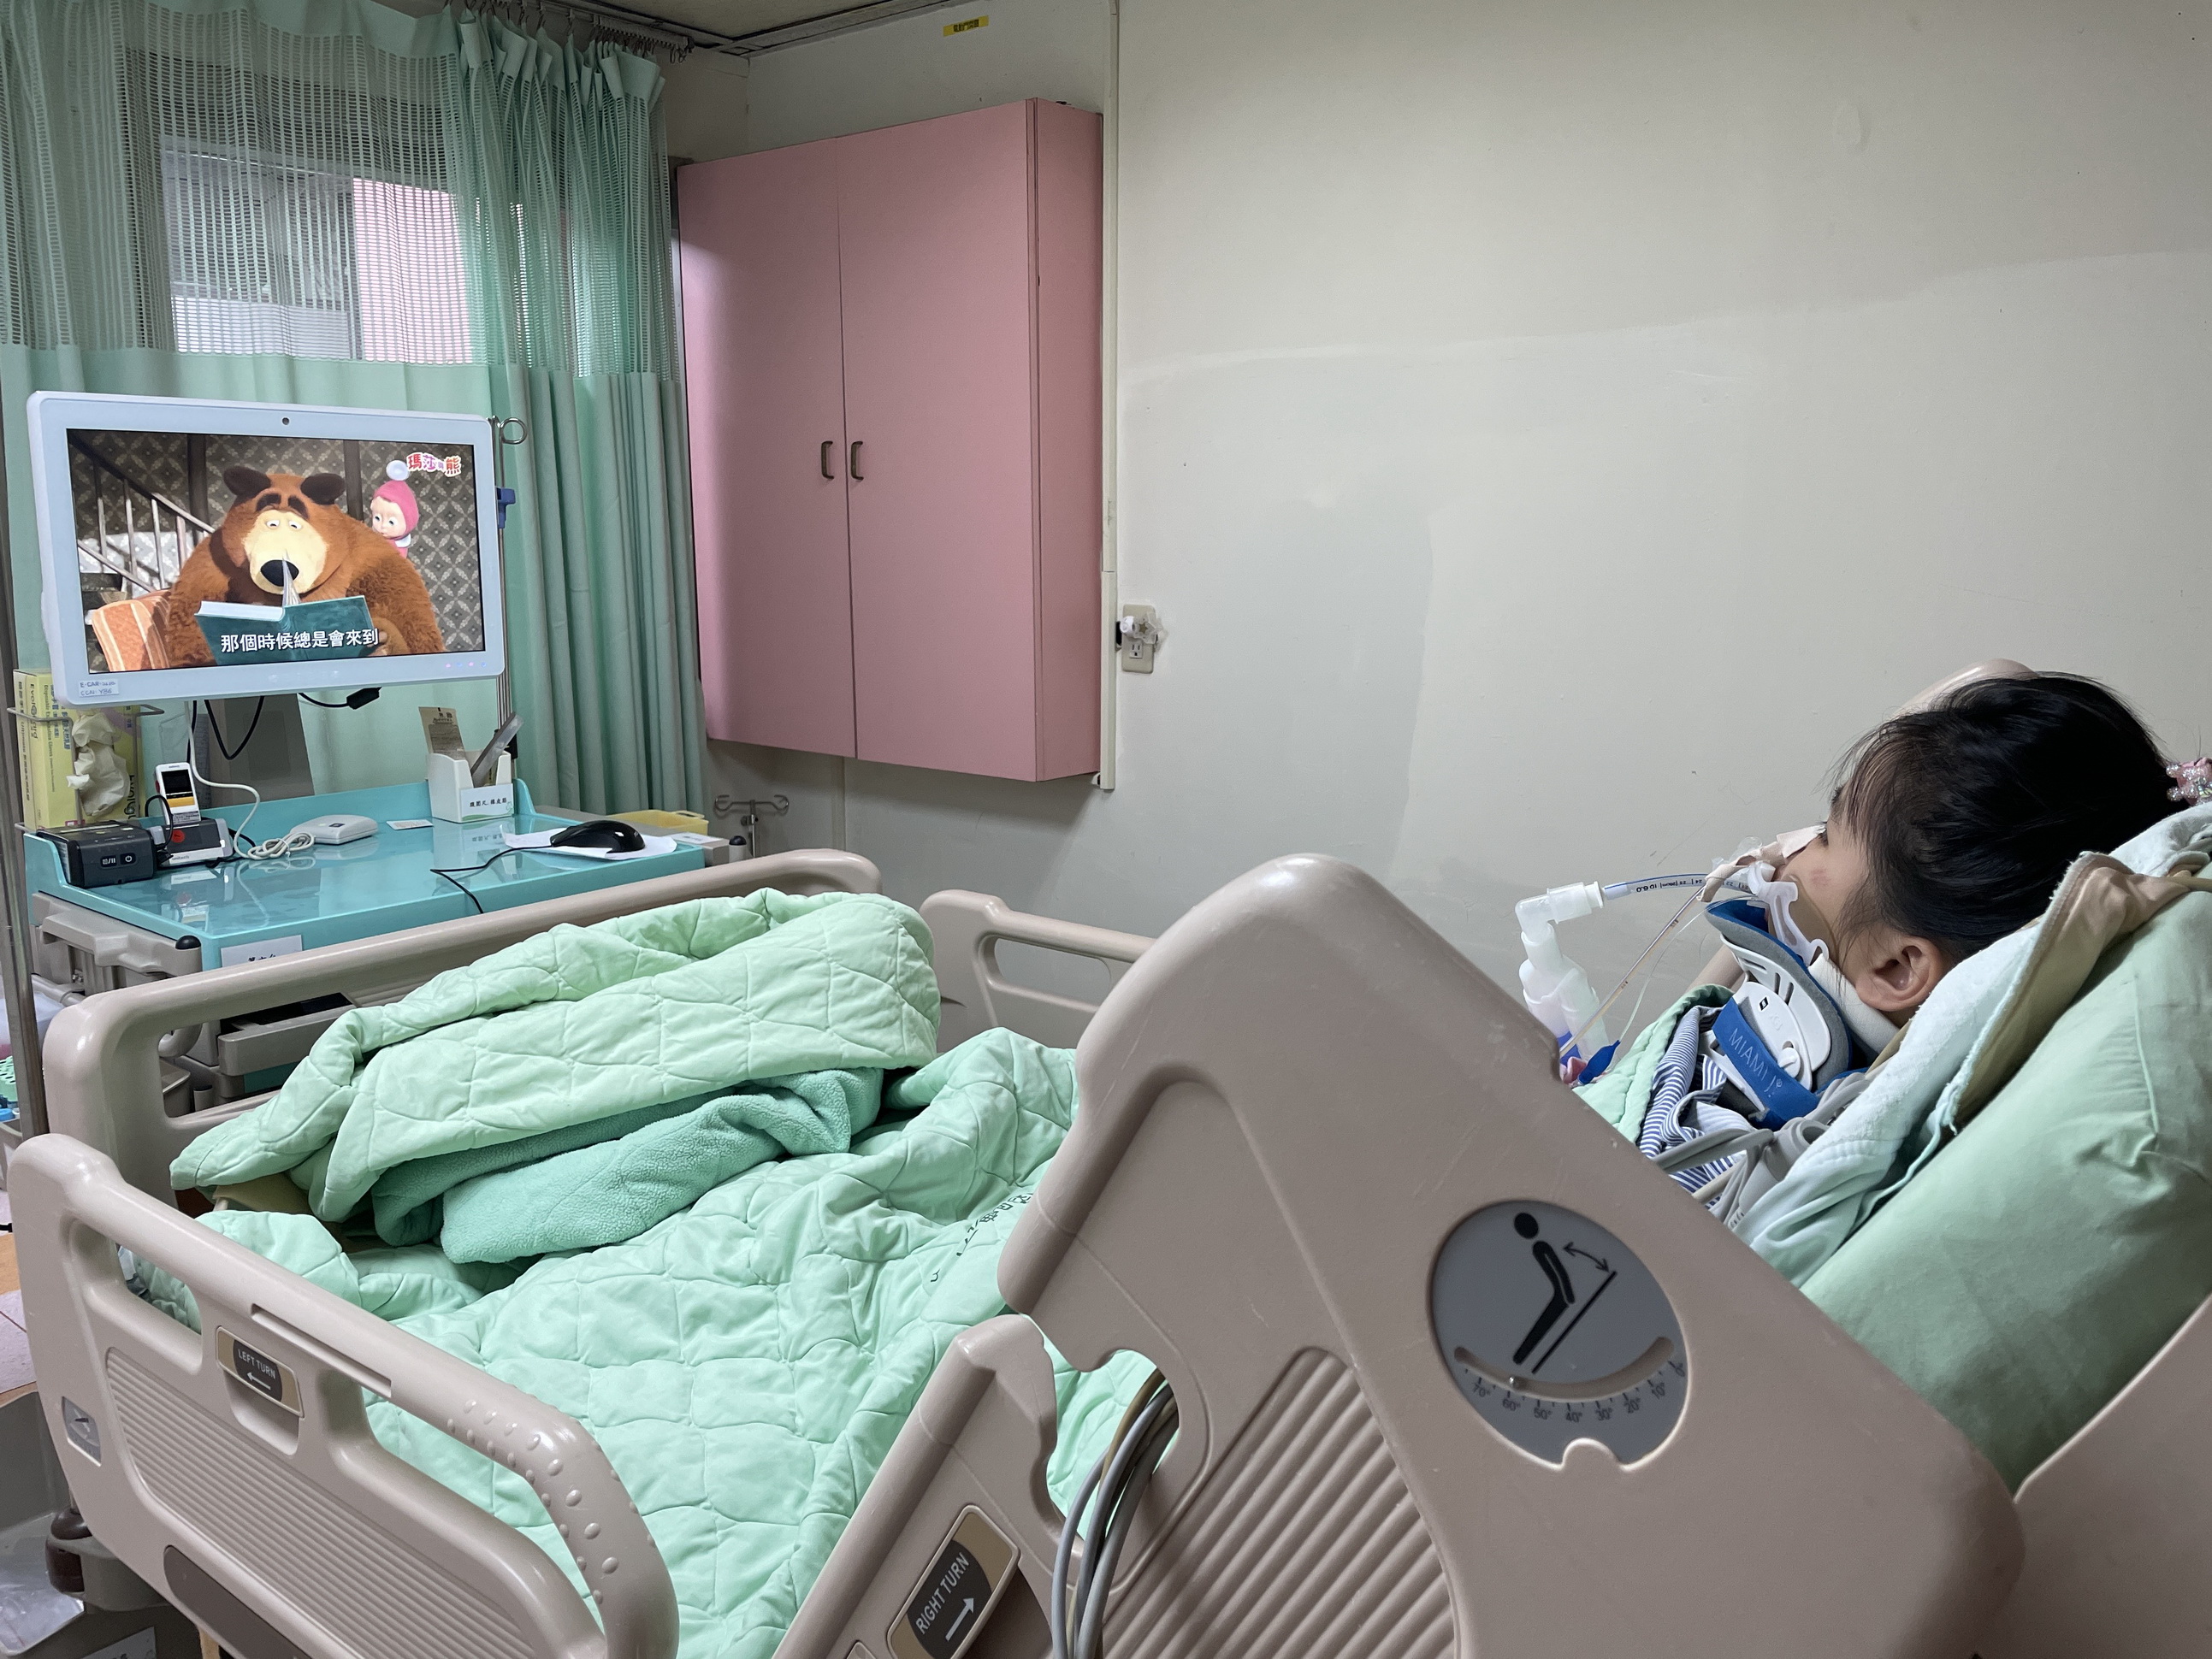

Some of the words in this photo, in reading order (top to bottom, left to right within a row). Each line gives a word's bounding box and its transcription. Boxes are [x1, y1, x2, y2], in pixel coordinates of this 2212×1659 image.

[221, 628, 379, 653] 那個時候總是會來到
[1728, 1027, 1769, 1081] MIAMI
[238, 1349, 255, 1366] LEFT
[256, 1360, 276, 1379] TURN
[915, 1587, 946, 1634] RIGHT
[940, 1552, 970, 1593] TURN
